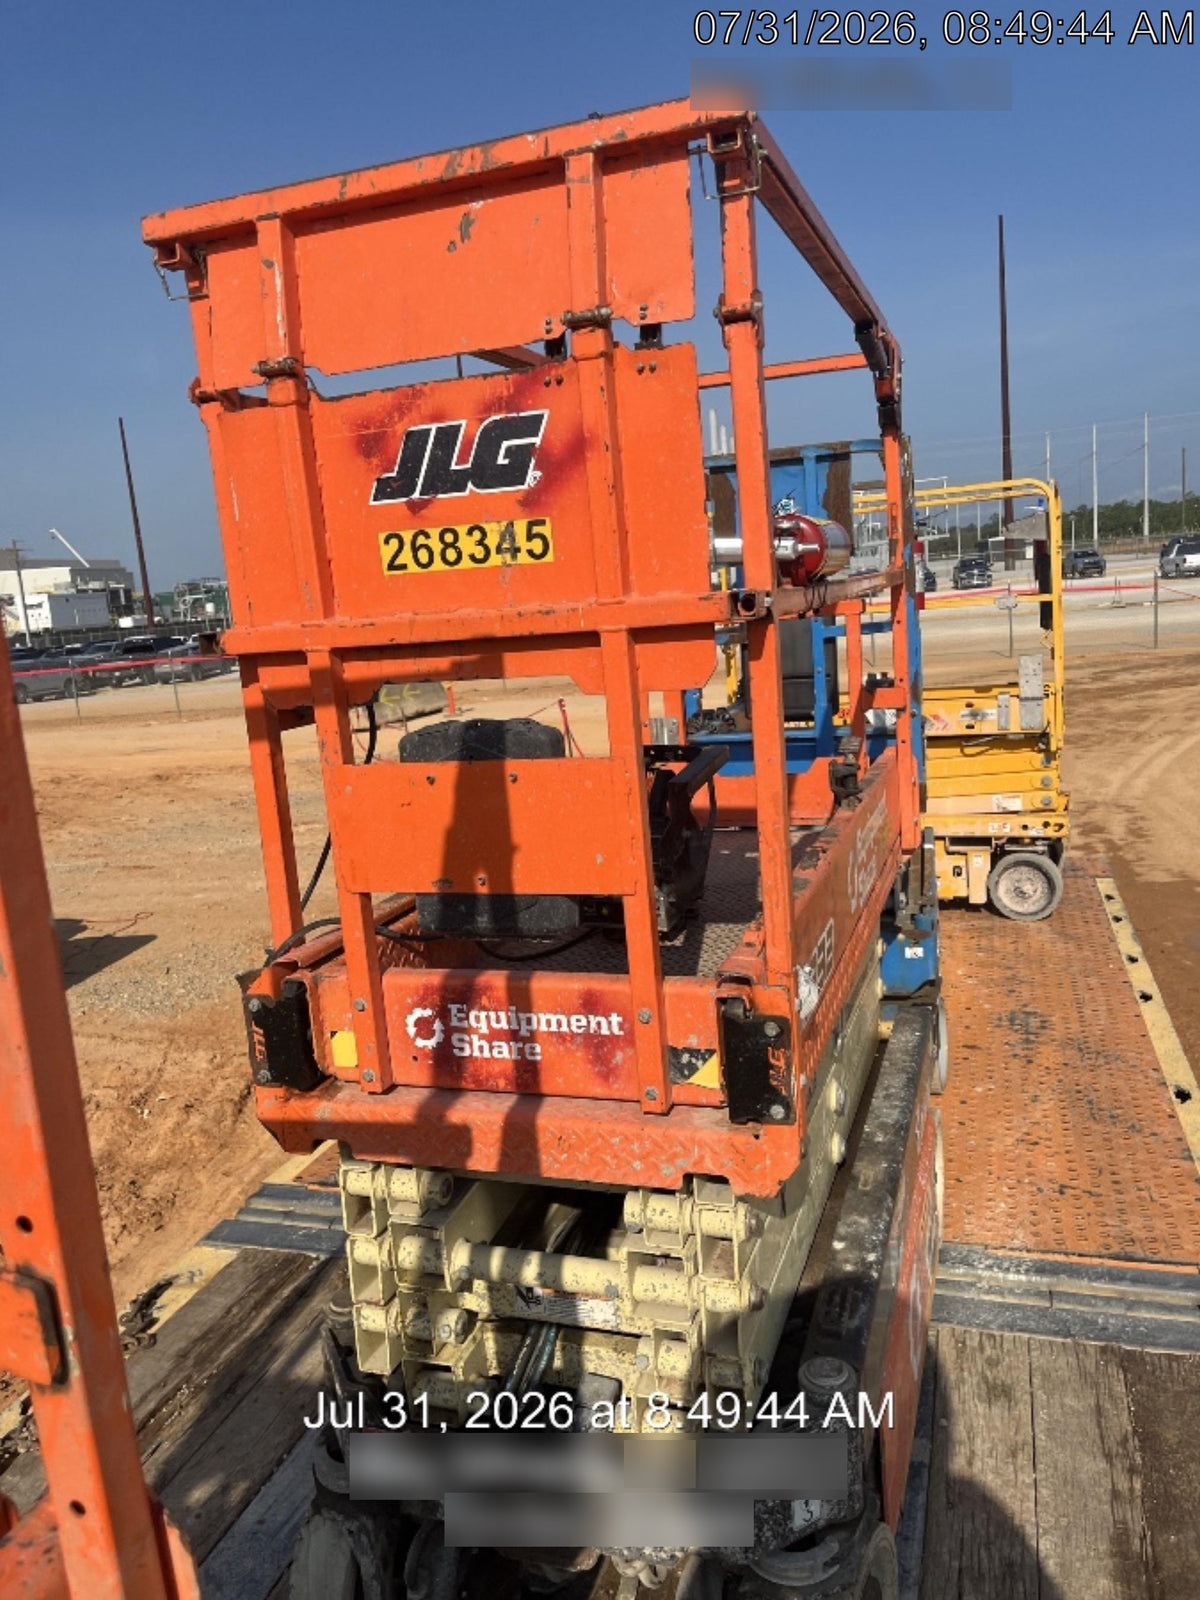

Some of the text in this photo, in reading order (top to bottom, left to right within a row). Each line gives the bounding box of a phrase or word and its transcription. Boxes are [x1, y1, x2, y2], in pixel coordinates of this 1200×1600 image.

[369, 409, 549, 505] JLG
[383, 518, 550, 572] 268345
[448, 1003, 625, 1037] Equipment
[450, 1033, 543, 1061] Share
